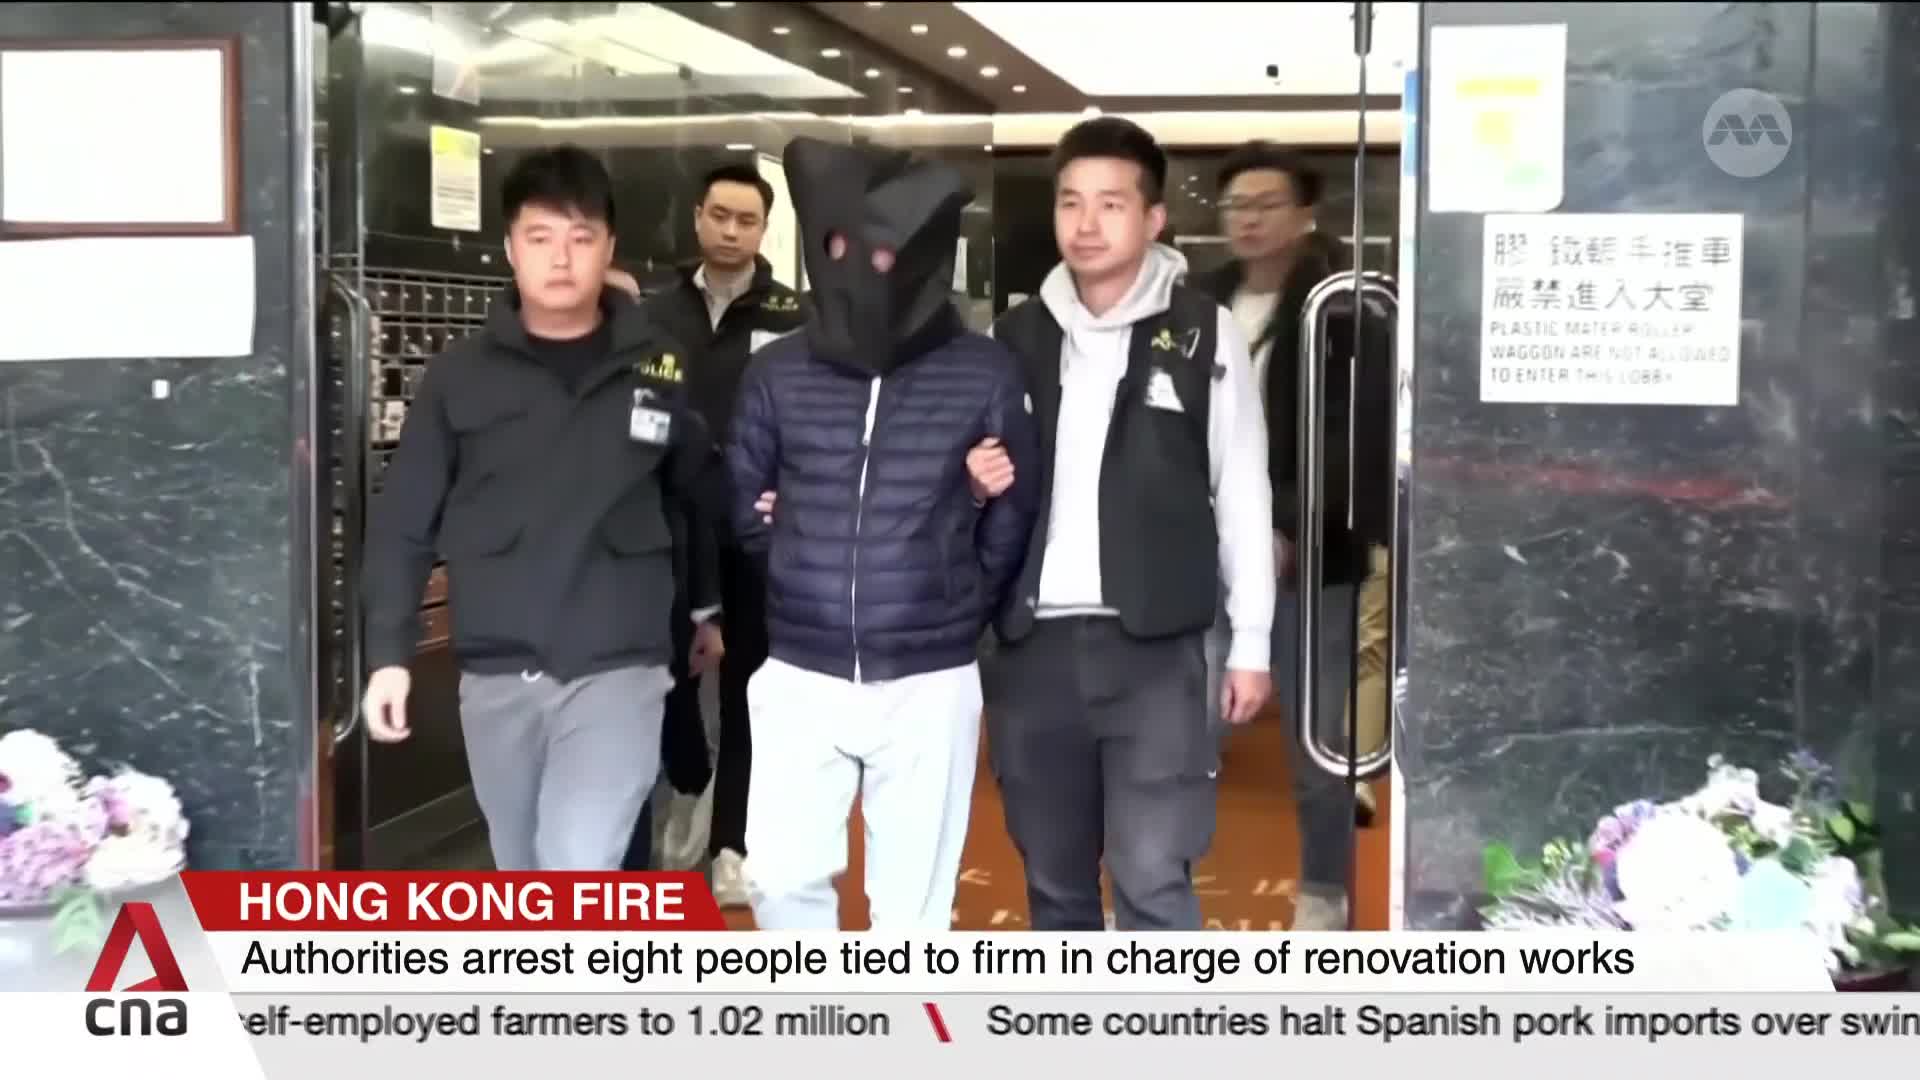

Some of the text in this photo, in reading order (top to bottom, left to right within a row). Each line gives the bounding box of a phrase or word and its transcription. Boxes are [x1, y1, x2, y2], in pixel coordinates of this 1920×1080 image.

[1492, 276, 1714, 312] 嚴禁進入大堂
[1489, 320, 1559, 337] PLASTIC
[1489, 344, 1566, 361] WAGGON
[1569, 344, 1602, 361] ARE
[1489, 367, 1512, 384] TO
[1514, 367, 1569, 384] ENTER
